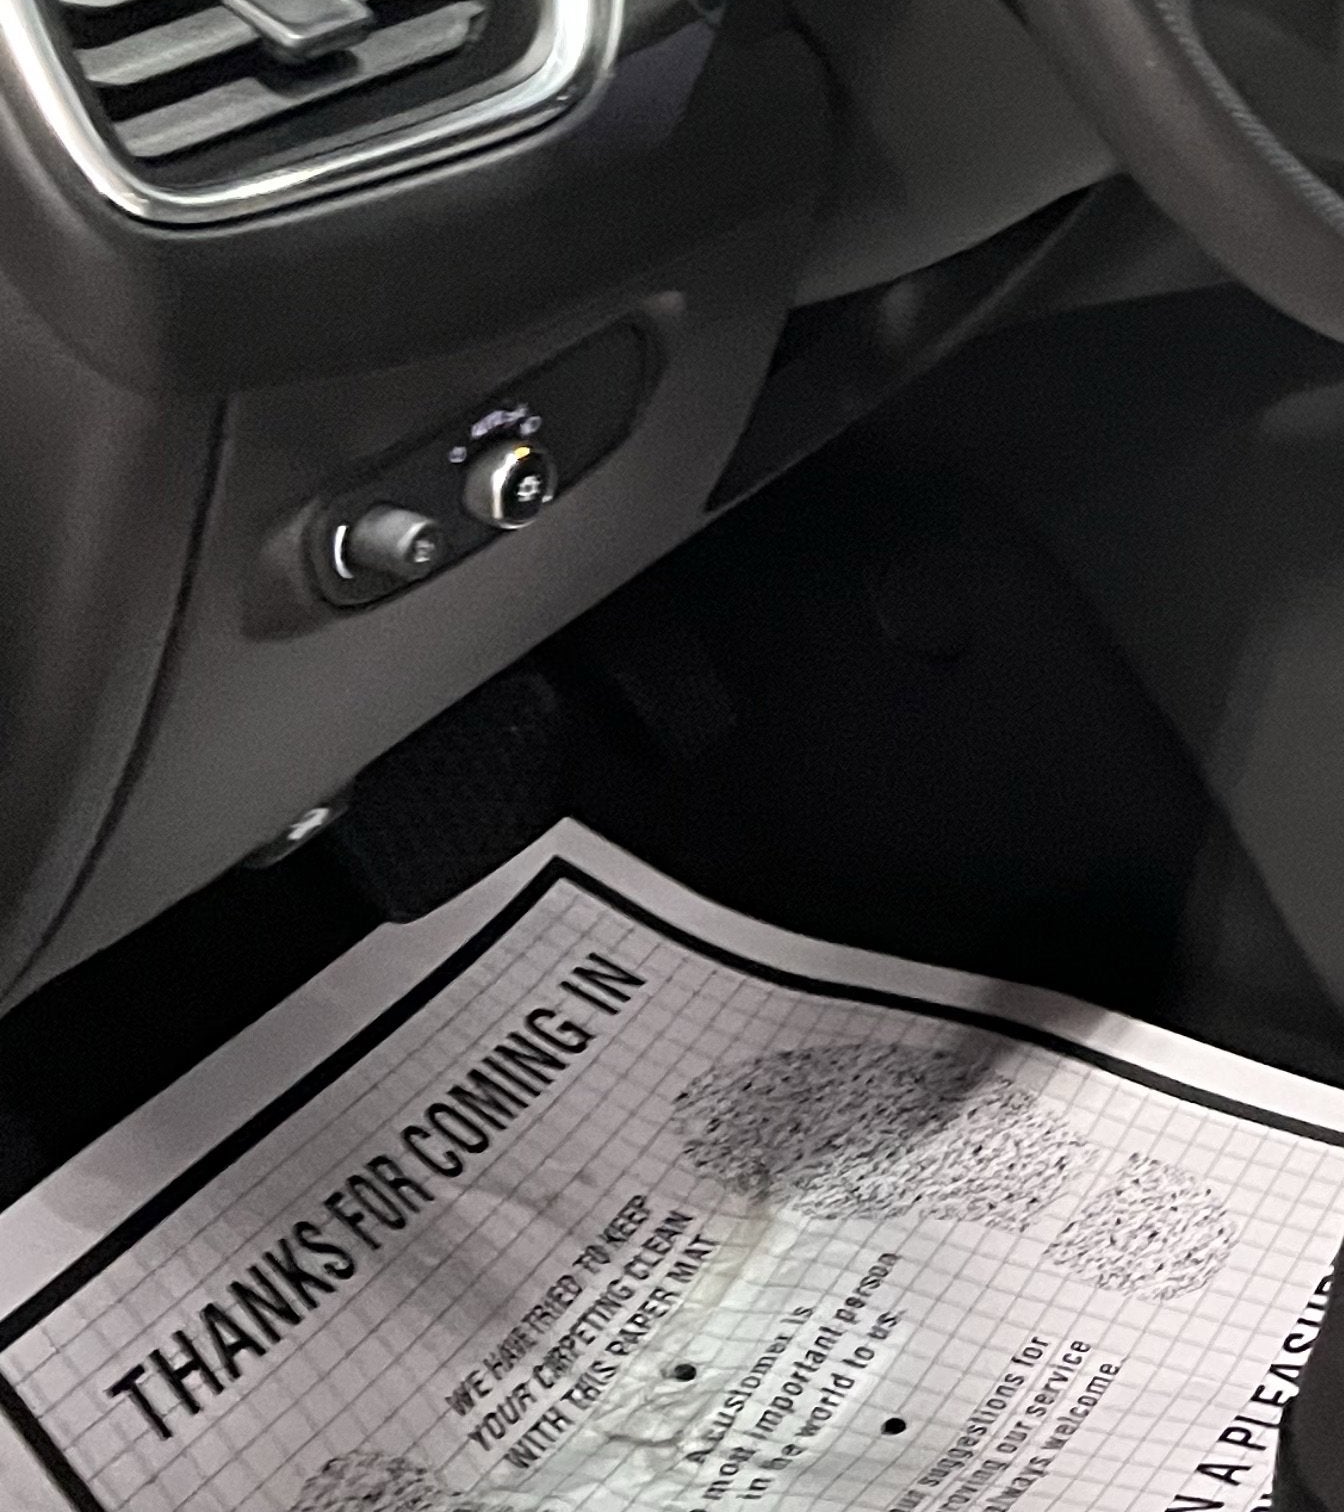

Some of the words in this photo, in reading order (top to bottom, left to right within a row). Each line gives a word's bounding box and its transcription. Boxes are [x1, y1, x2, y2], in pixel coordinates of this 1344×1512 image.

[106, 1220, 355, 1440] THANKS
[322, 1154, 435, 1251] FOR
[400, 1007, 598, 1178] COMING
[560, 952, 648, 1016] IN
[445, 1369, 492, 1417] WE
[521, 1274, 584, 1334] TRIED
[572, 1243, 612, 1274] TO
[599, 1194, 651, 1249] KEEP
[468, 1382, 538, 1452] YOUR
[623, 1209, 695, 1281] CLEAN
[503, 1405, 576, 1470] WITH
[559, 1360, 620, 1411] THIS
[605, 1286, 681, 1356] PAPER
[666, 1233, 721, 1284] MAT
[747, 1324, 845, 1441] important
[834, 1252, 901, 1326] person
[779, 1305, 816, 1326] is
[736, 1476, 776, 1500] in
[794, 1372, 856, 1438] world
[841, 1345, 876, 1370] to
[918, 1371, 1026, 1488] suggestions
[1010, 1335, 1051, 1368] for
[937, 1458, 1012, 1512] roving
[995, 1420, 1035, 1455] our
[1025, 1339, 1093, 1418] service
[1195, 1462, 1254, 1487] A
